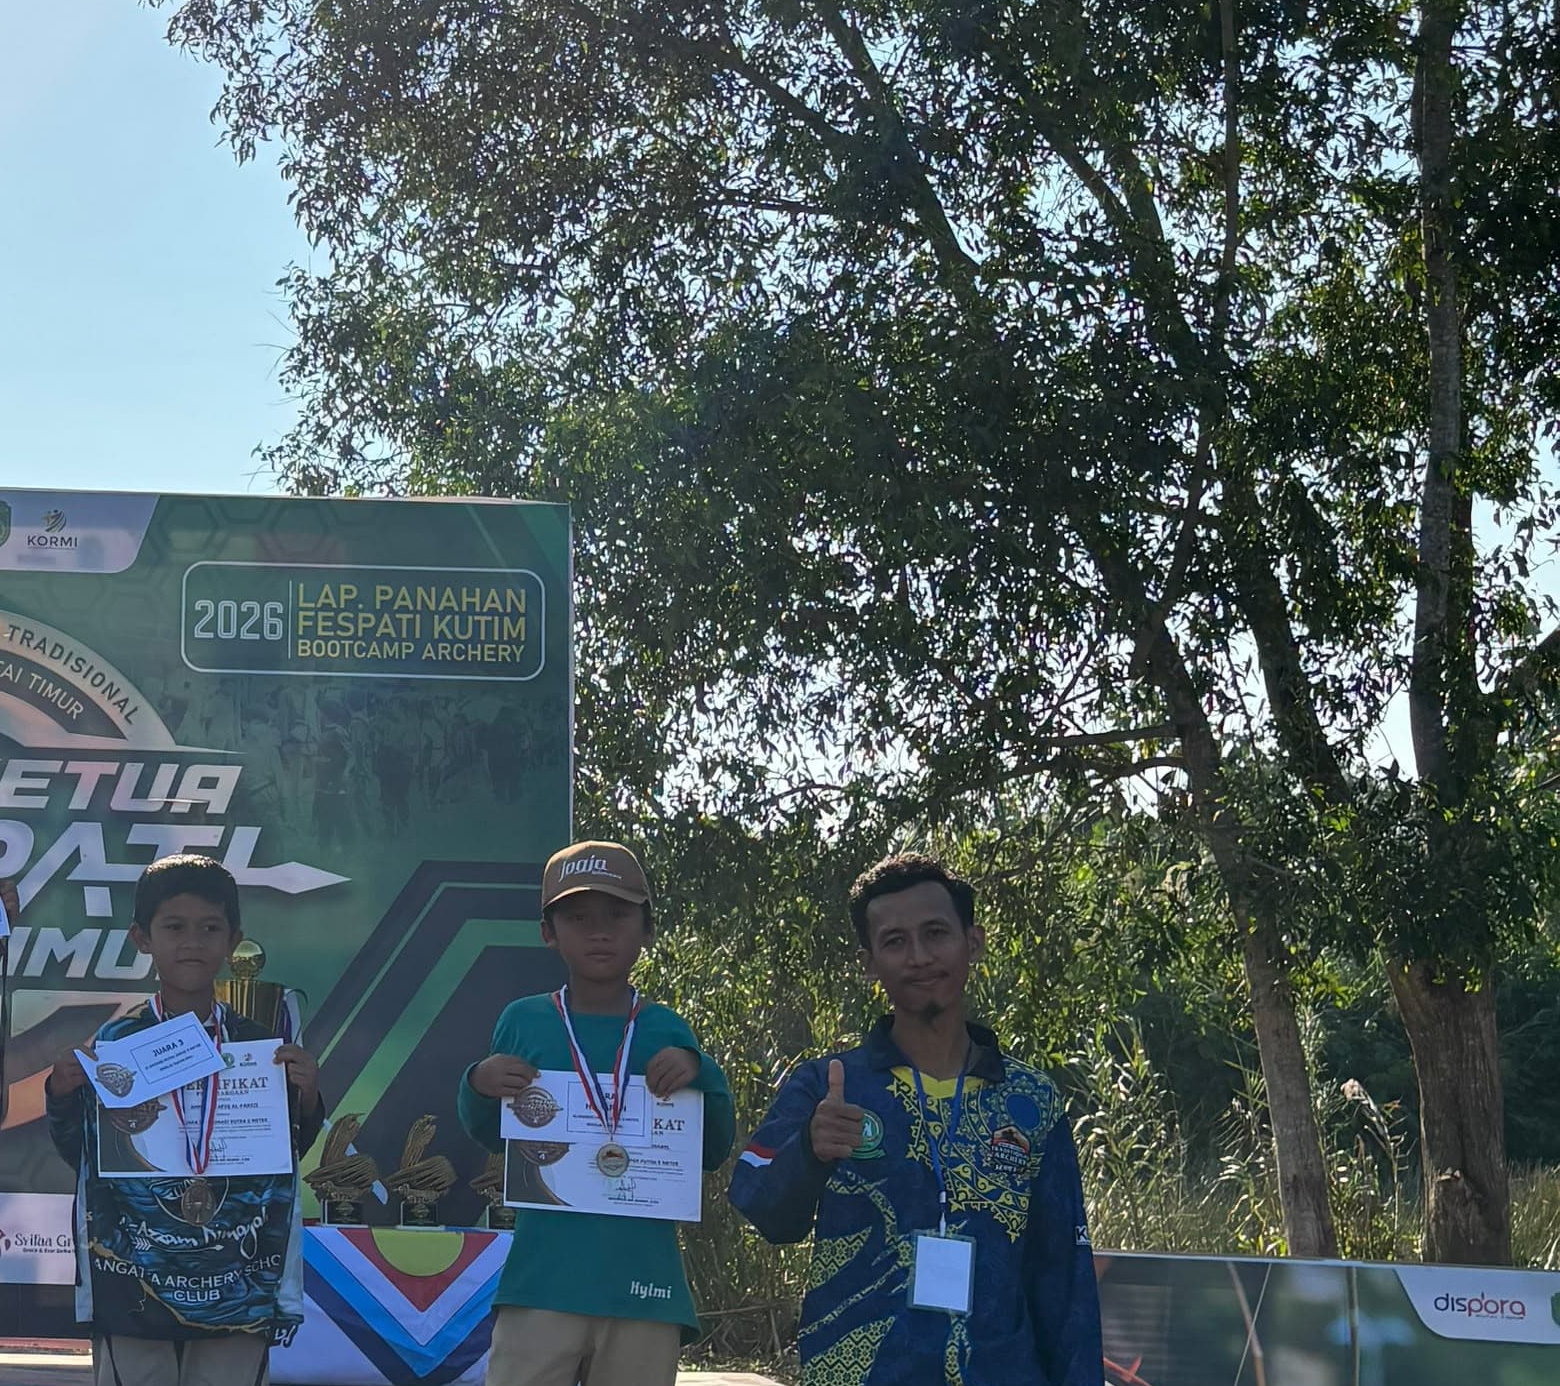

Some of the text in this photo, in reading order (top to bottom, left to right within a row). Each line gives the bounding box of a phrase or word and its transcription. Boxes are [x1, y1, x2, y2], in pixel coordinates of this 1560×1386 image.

[26, 534, 78, 549] KORMI
[296, 582, 528, 614] LAP. PANAHAN
[192, 598, 284, 641] 2026
[296, 612, 528, 643] FESPATI KUTIM
[296, 639, 526, 663] BOOTCAMP ARCHERY
[6, 624, 140, 726] TRADISIONAL
[27, 672, 85, 721] TIMUR
[152, 1041, 178, 1057] JUARA
[165, 1269, 243, 1289] ARCHERY
[630, 1280, 672, 1300] Hylmi
[173, 1289, 221, 1302] CLUB
[1433, 1291, 1526, 1317] dispora
